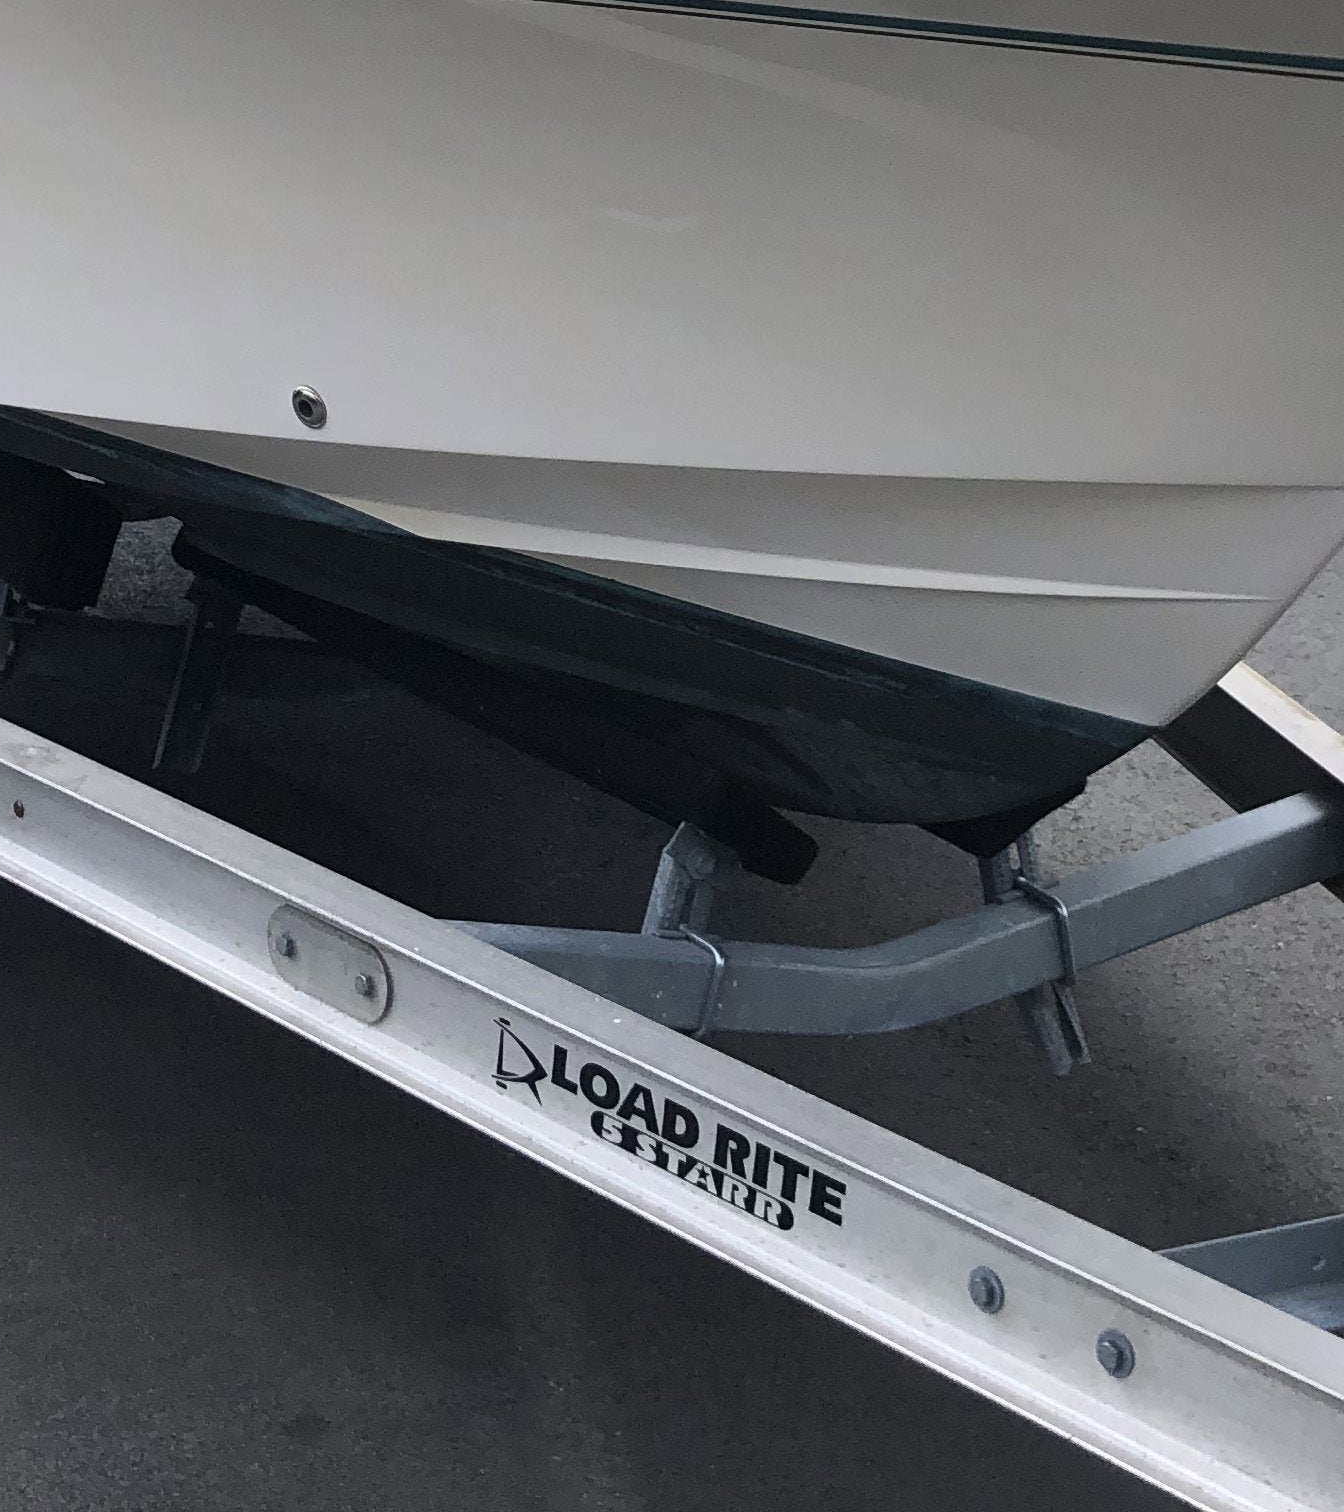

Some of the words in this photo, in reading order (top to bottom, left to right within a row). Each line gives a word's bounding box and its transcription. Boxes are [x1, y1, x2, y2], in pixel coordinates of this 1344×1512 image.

[551, 1044, 700, 1149] LOAD
[713, 1122, 848, 1226] RITE
[601, 1117, 624, 1145] 5
